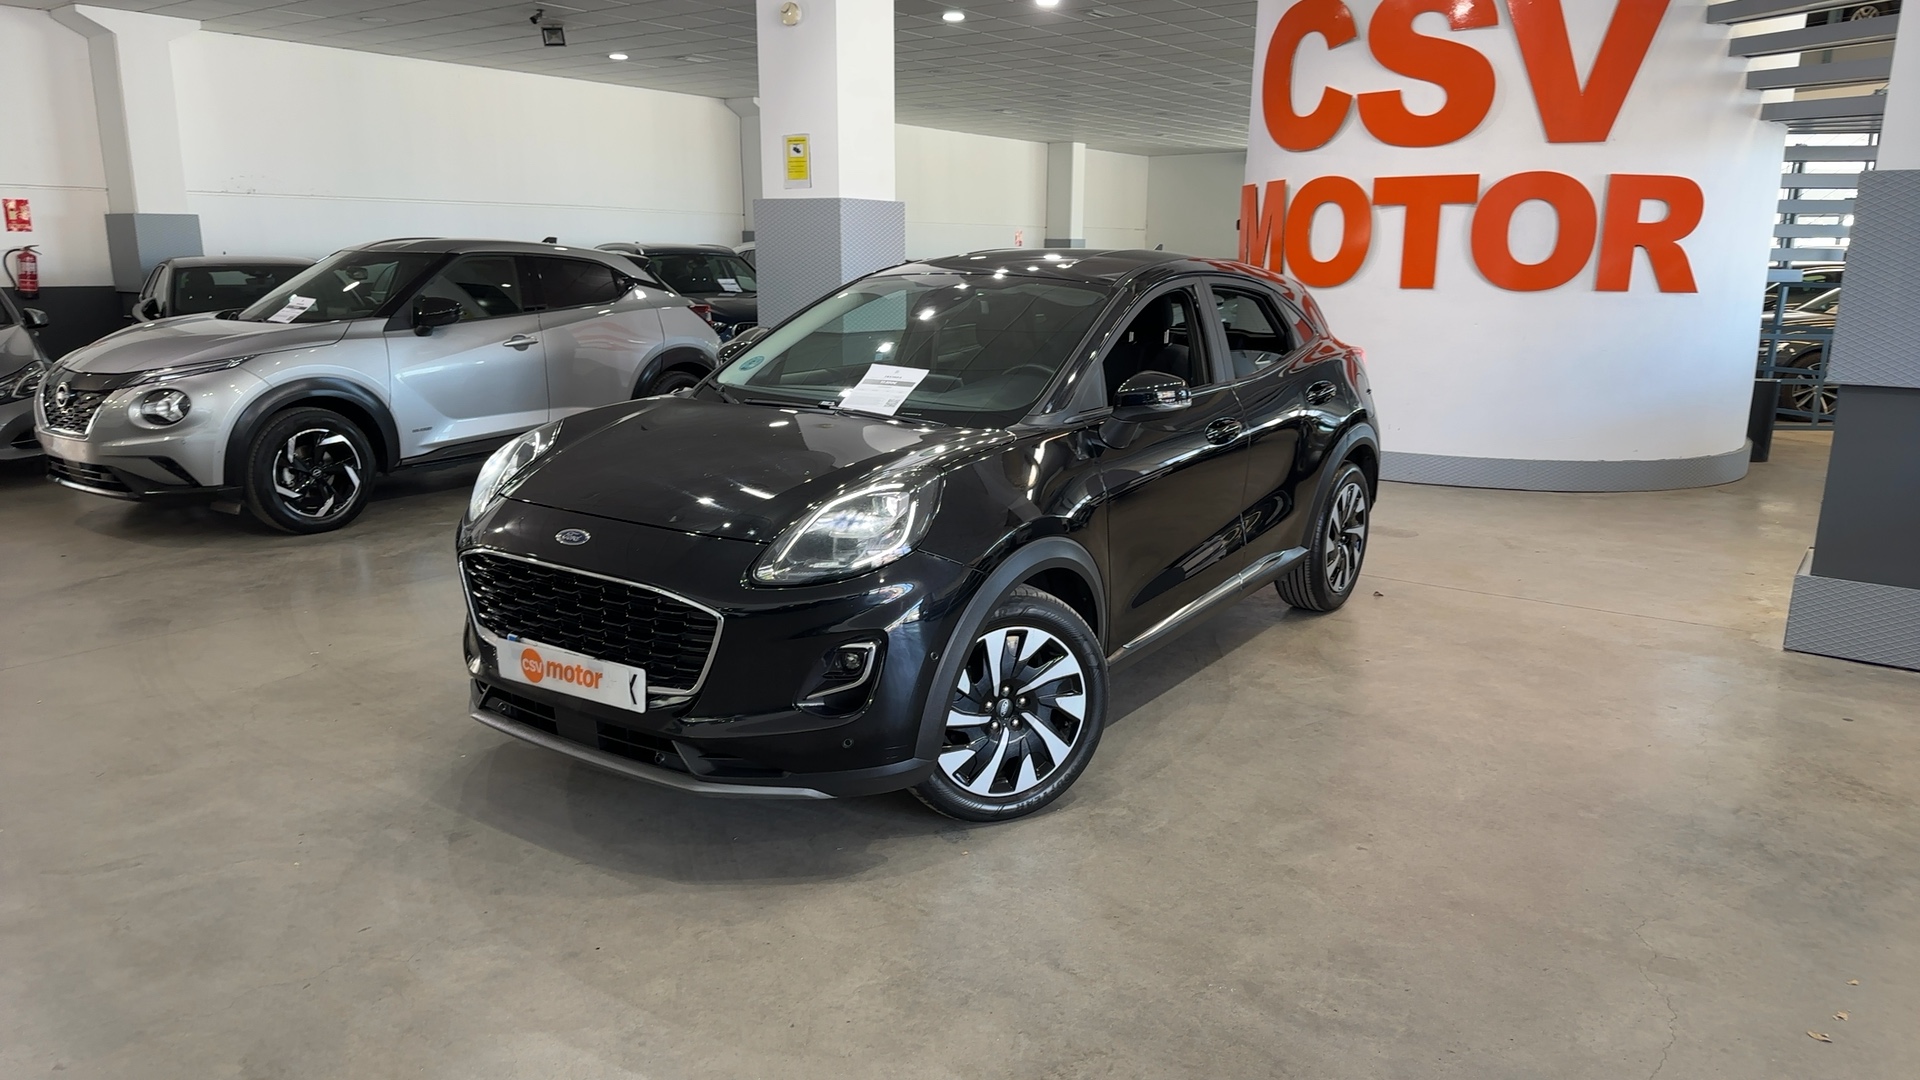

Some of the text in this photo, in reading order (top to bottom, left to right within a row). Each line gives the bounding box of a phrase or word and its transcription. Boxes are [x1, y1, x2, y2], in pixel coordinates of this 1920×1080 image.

[1262, 0, 1671, 152] CSV
[1239, 170, 1705, 294] MOTOR
[546, 659, 603, 689] motor
